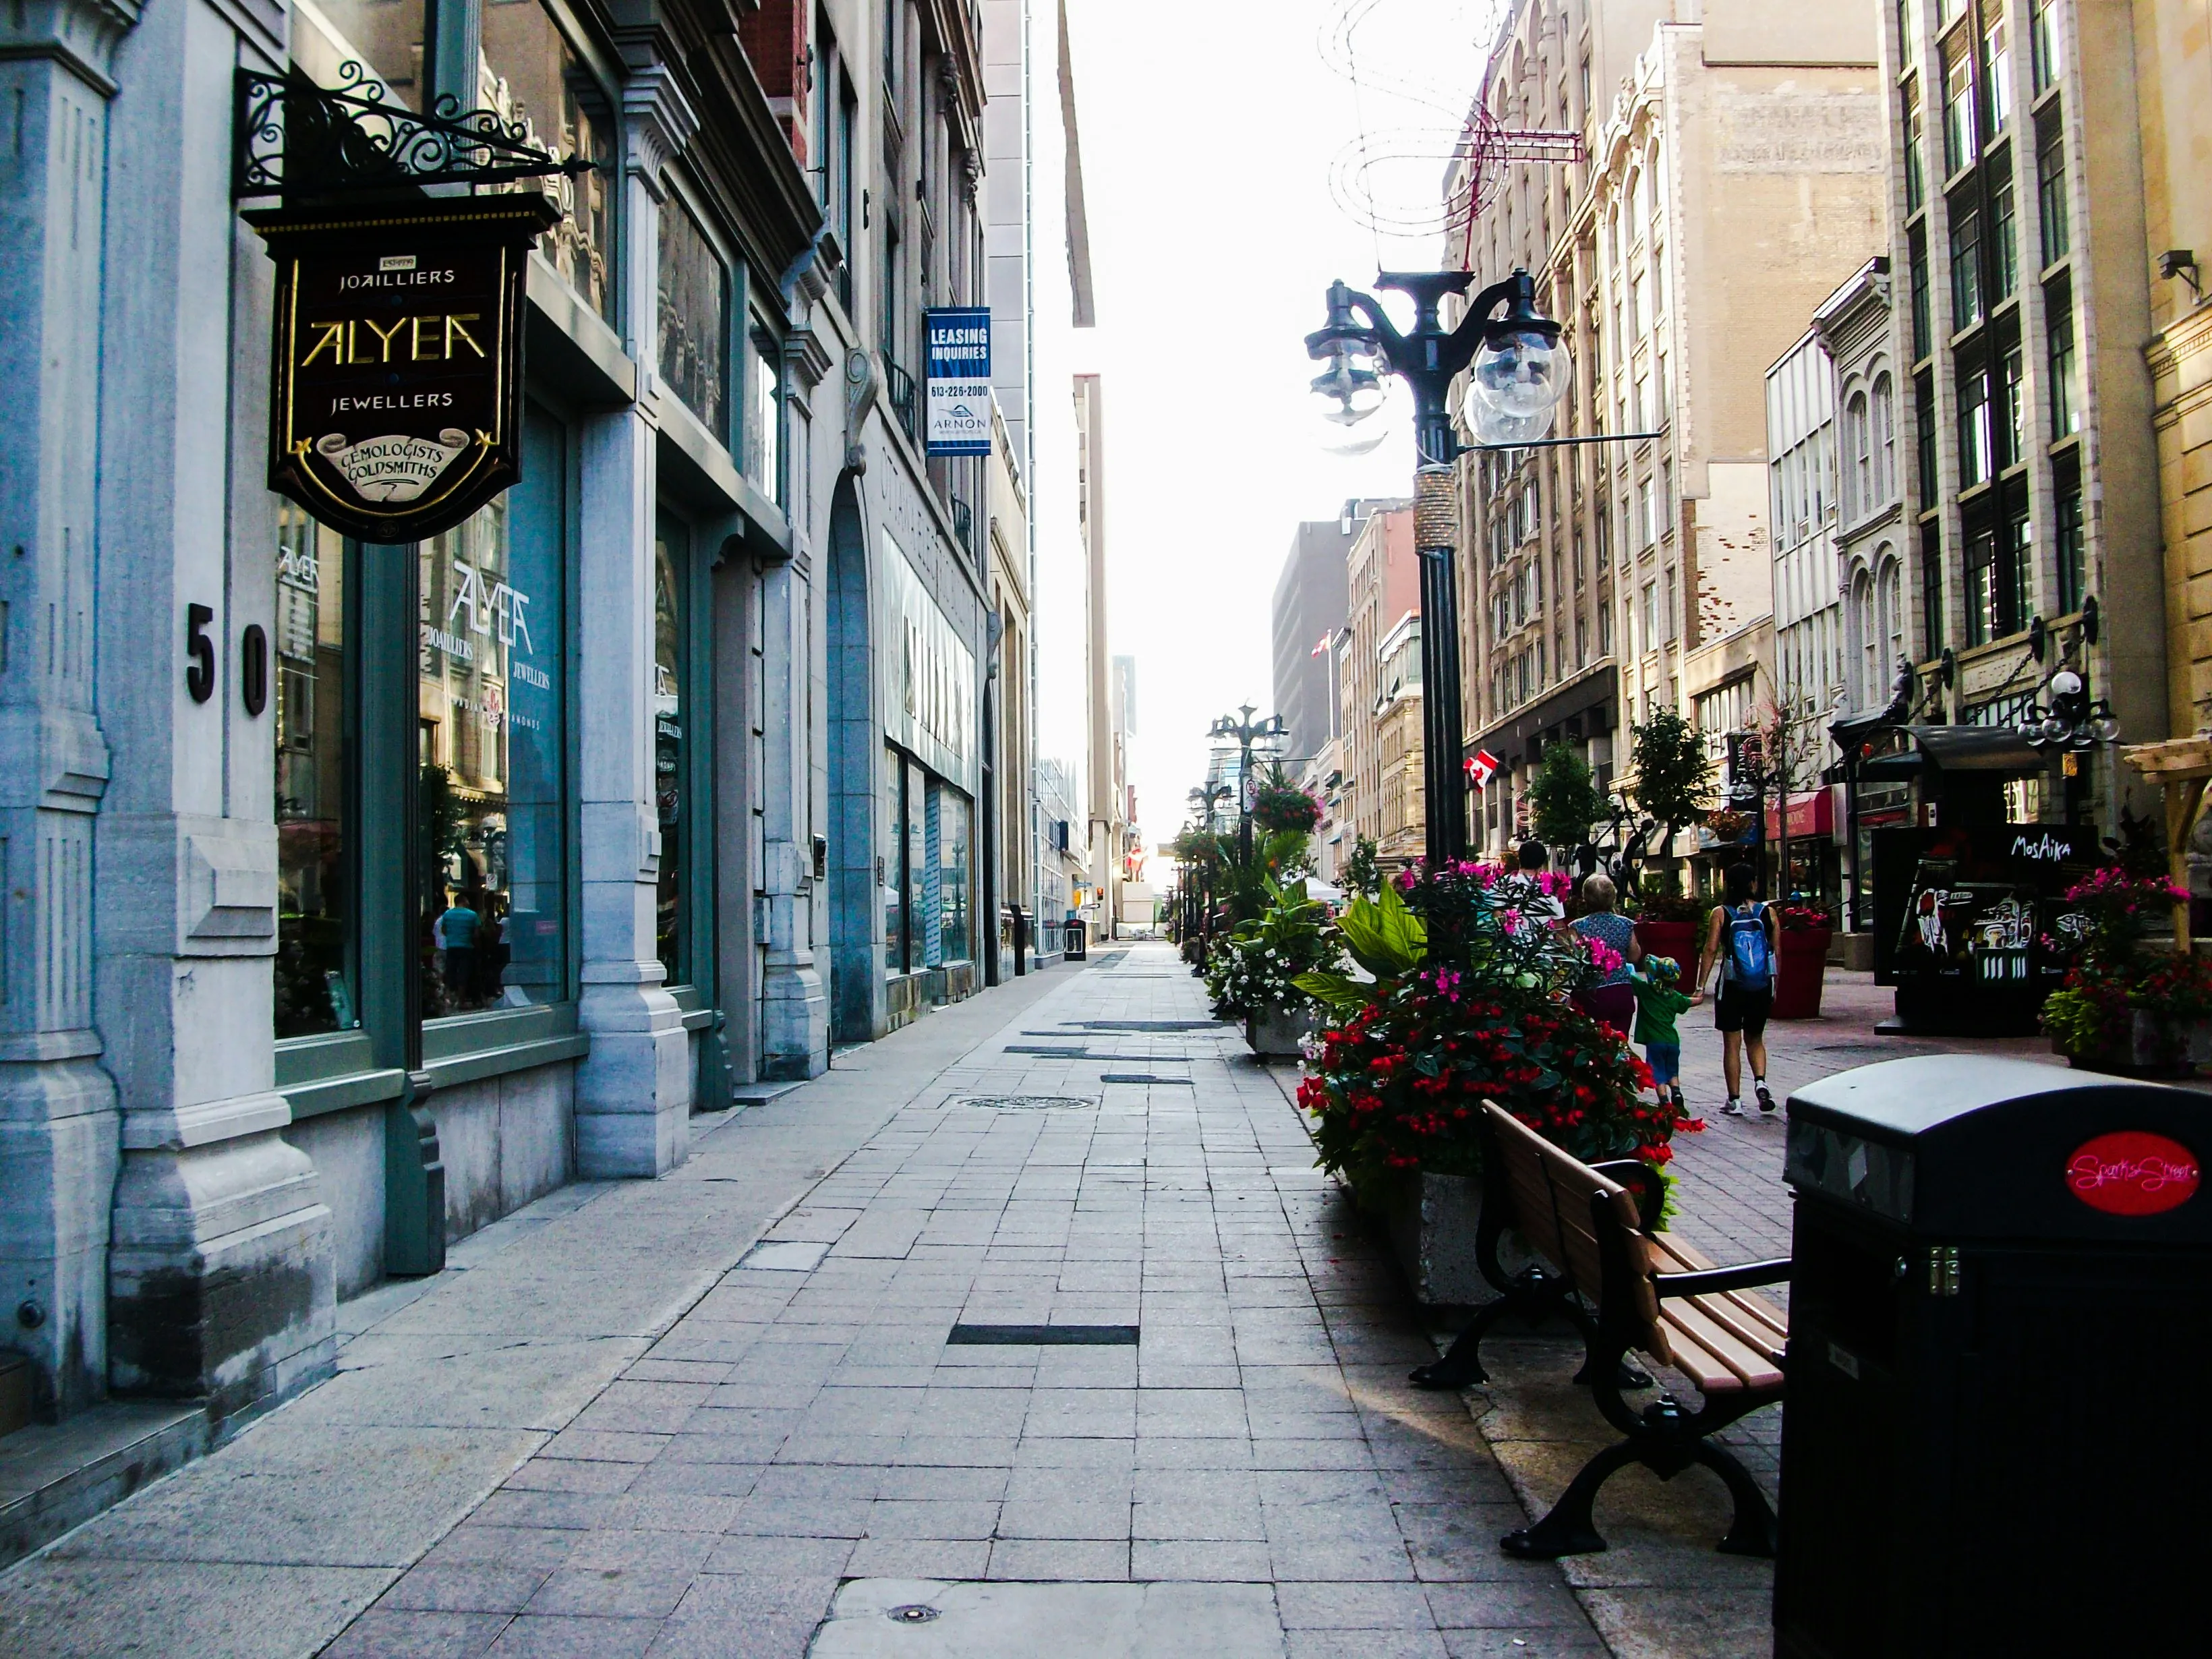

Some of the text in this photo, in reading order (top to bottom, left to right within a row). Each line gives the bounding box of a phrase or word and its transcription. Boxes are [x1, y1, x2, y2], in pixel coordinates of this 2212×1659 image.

[339, 270, 455, 293] JOAILLIERS
[301, 313, 488, 367] ALYEA
[931, 328, 988, 345] LEASING
[931, 345, 987, 362] INQUIRIES
[330, 392, 453, 417] JEWELLERS
[934, 419, 987, 429] ARNON
[341, 443, 444, 469] GEMOLOGISTS
[348, 461, 438, 485] GOLDSMITHS
[449, 560, 533, 656] ALYEA
[428, 627, 550, 691] JOAILLIERS JEWELLERS
